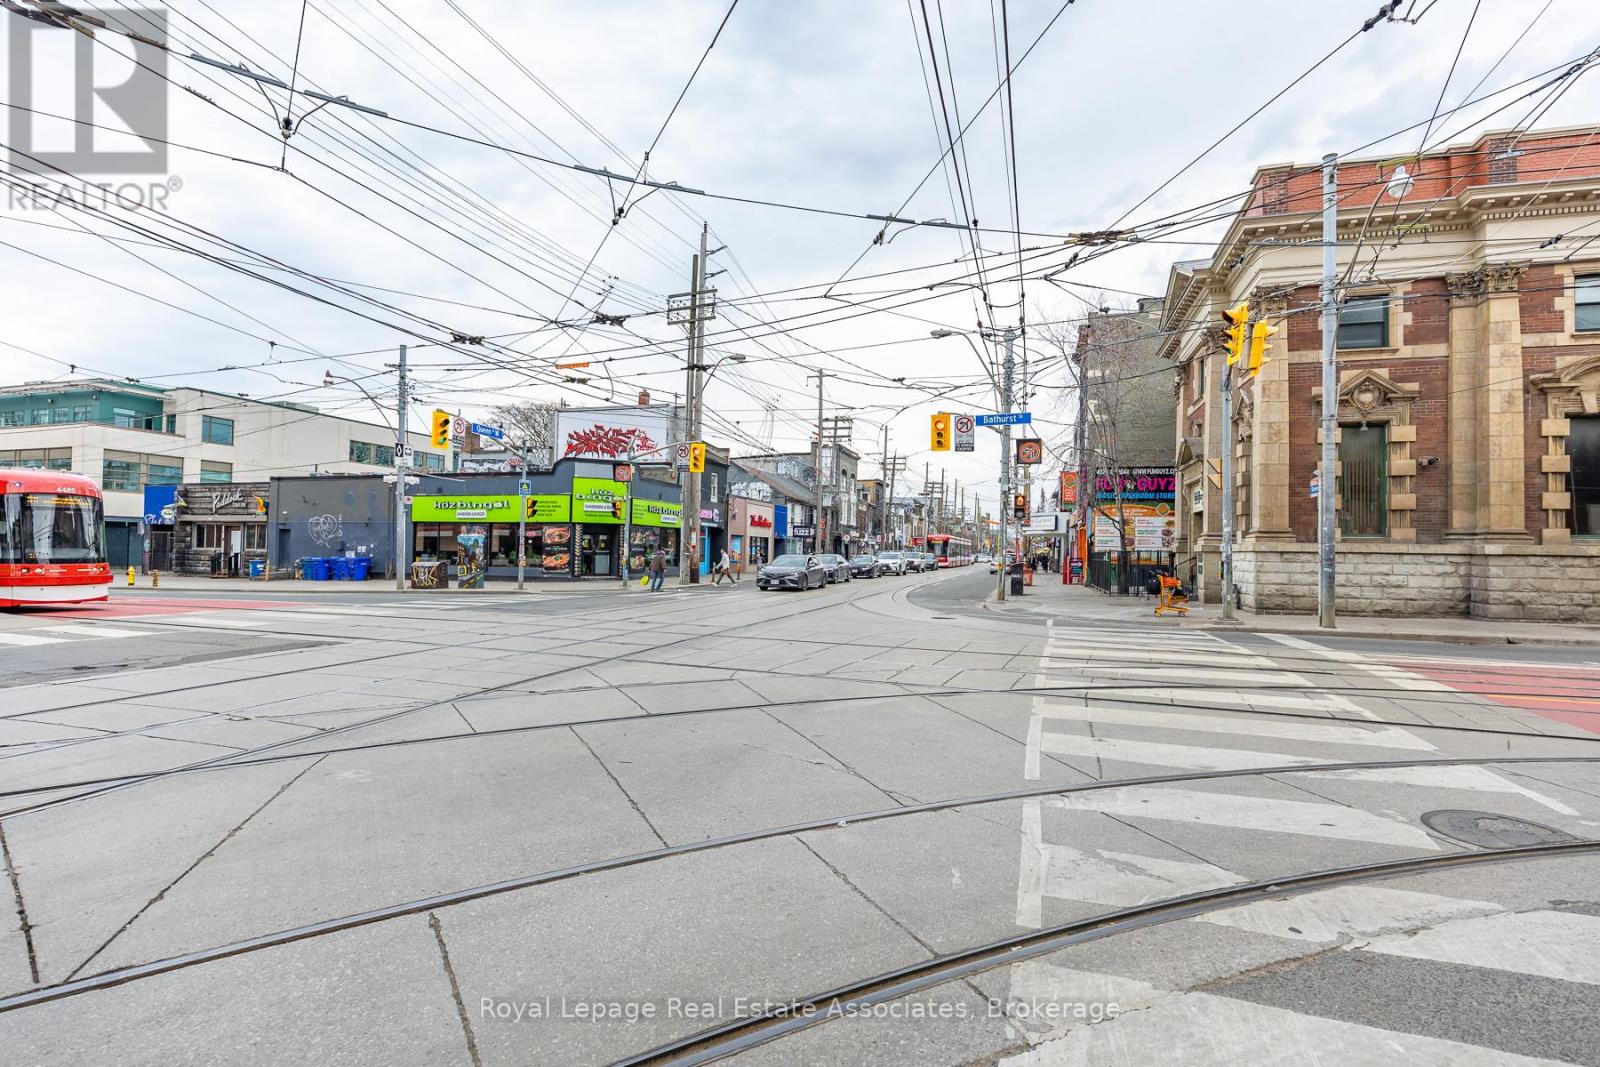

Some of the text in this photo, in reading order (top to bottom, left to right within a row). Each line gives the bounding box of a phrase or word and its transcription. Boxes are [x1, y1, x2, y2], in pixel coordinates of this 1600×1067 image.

[983, 414, 1017, 424] Bathurst
[476, 424, 492, 436] Queen
[1137, 476, 1175, 491] GUYZ
[212, 487, 244, 514] Paddock
